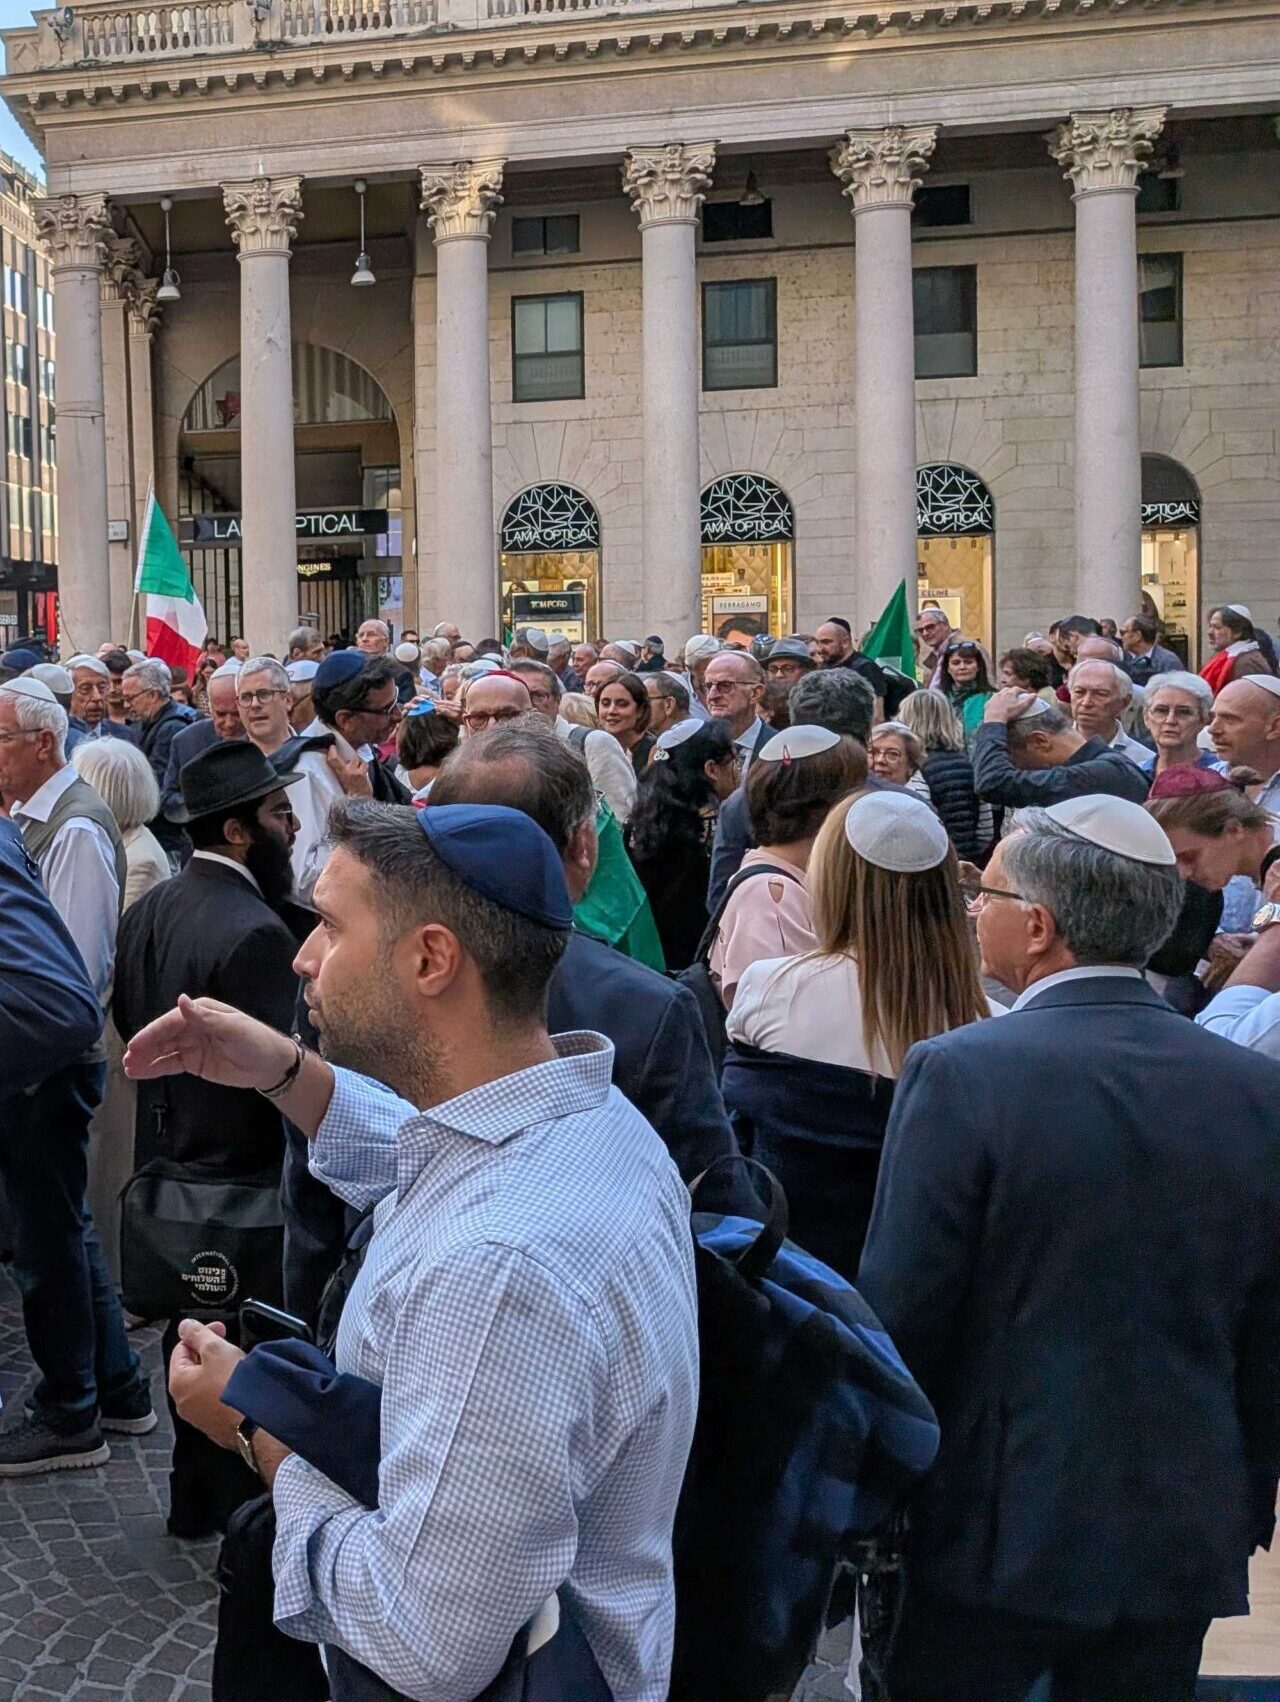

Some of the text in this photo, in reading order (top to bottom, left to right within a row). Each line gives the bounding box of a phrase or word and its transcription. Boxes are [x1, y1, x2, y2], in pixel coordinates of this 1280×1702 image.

[1141, 502, 1195, 517] OPTICAL
[933, 511, 989, 524] OPTICAL
[213, 514, 365, 538] LA PTICAL
[703, 519, 789, 533] AMA OPTICAL
[505, 528, 595, 543] LAMA OPTICAL
[297, 562, 331, 572] NGINES
